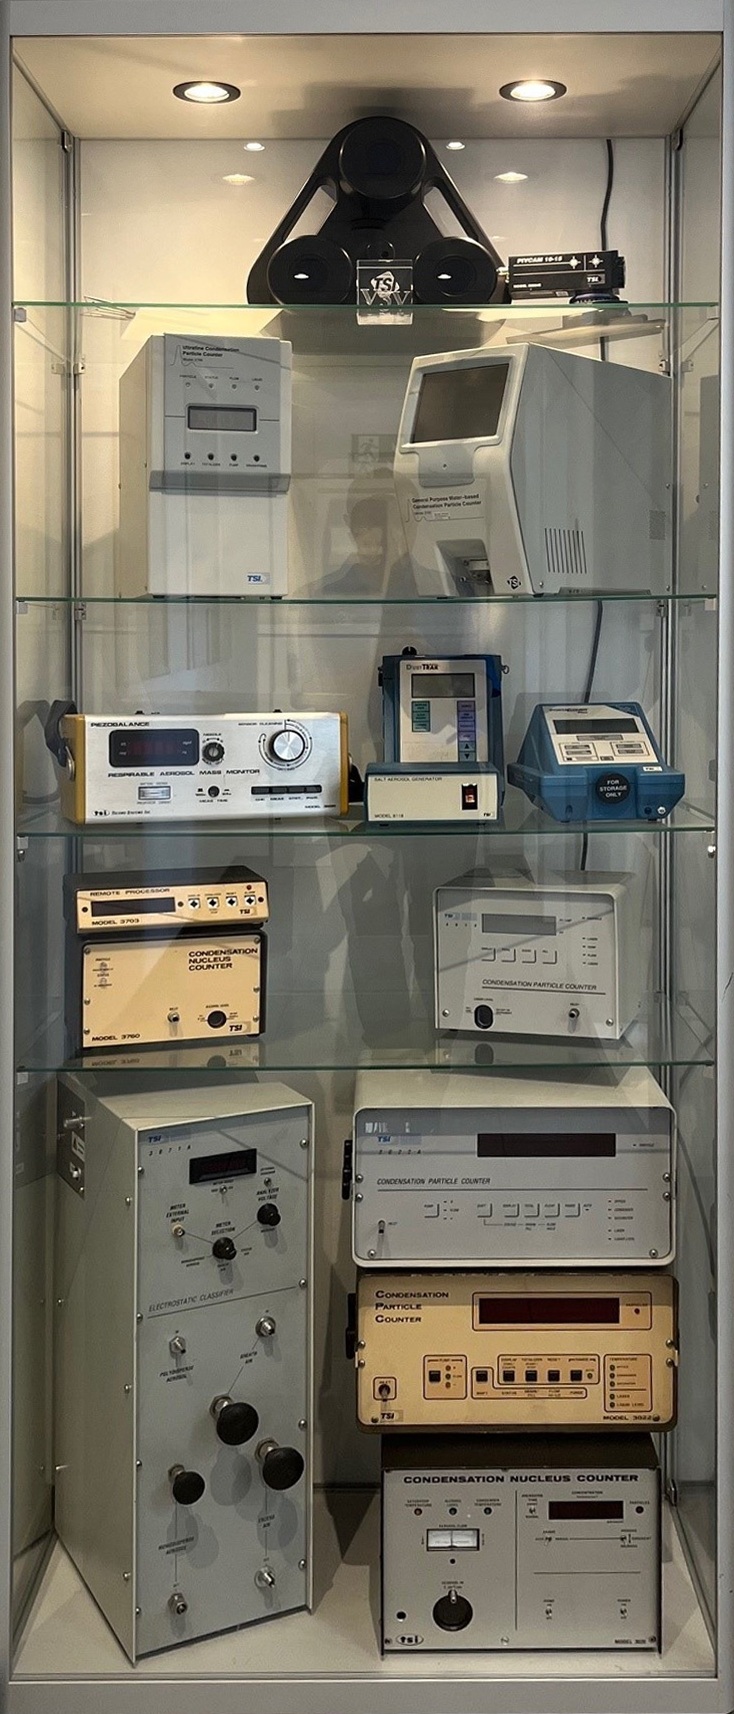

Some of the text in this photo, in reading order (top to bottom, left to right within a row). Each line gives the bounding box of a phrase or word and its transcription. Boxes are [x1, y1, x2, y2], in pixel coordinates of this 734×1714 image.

[374, 277, 396, 291] TSI
[188, 948, 258, 958] CONDENSATION
[188, 956, 232, 965] NUCLEUS
[188, 962, 233, 972] COUNTER
[482, 978, 597, 991] CONDENSATION PARTICLE COUNTER
[229, 1024, 243, 1032] TSI
[148, 1135, 162, 1143] TSI
[376, 1177, 491, 1185] CONDENSATION PARTICLE COUNTER
[169, 1203, 186, 1211] METER
[166, 1210, 190, 1218] EXTERNAL
[215, 1221, 231, 1229] METER
[148, 1288, 235, 1313] ELECTROSTATIC CLASSIFIER
[380, 1412, 395, 1420] TSI
[403, 1474, 639, 1484] CONDENSATION NUCLEUS COUNTER
[400, 1635, 419, 1644] tsi
